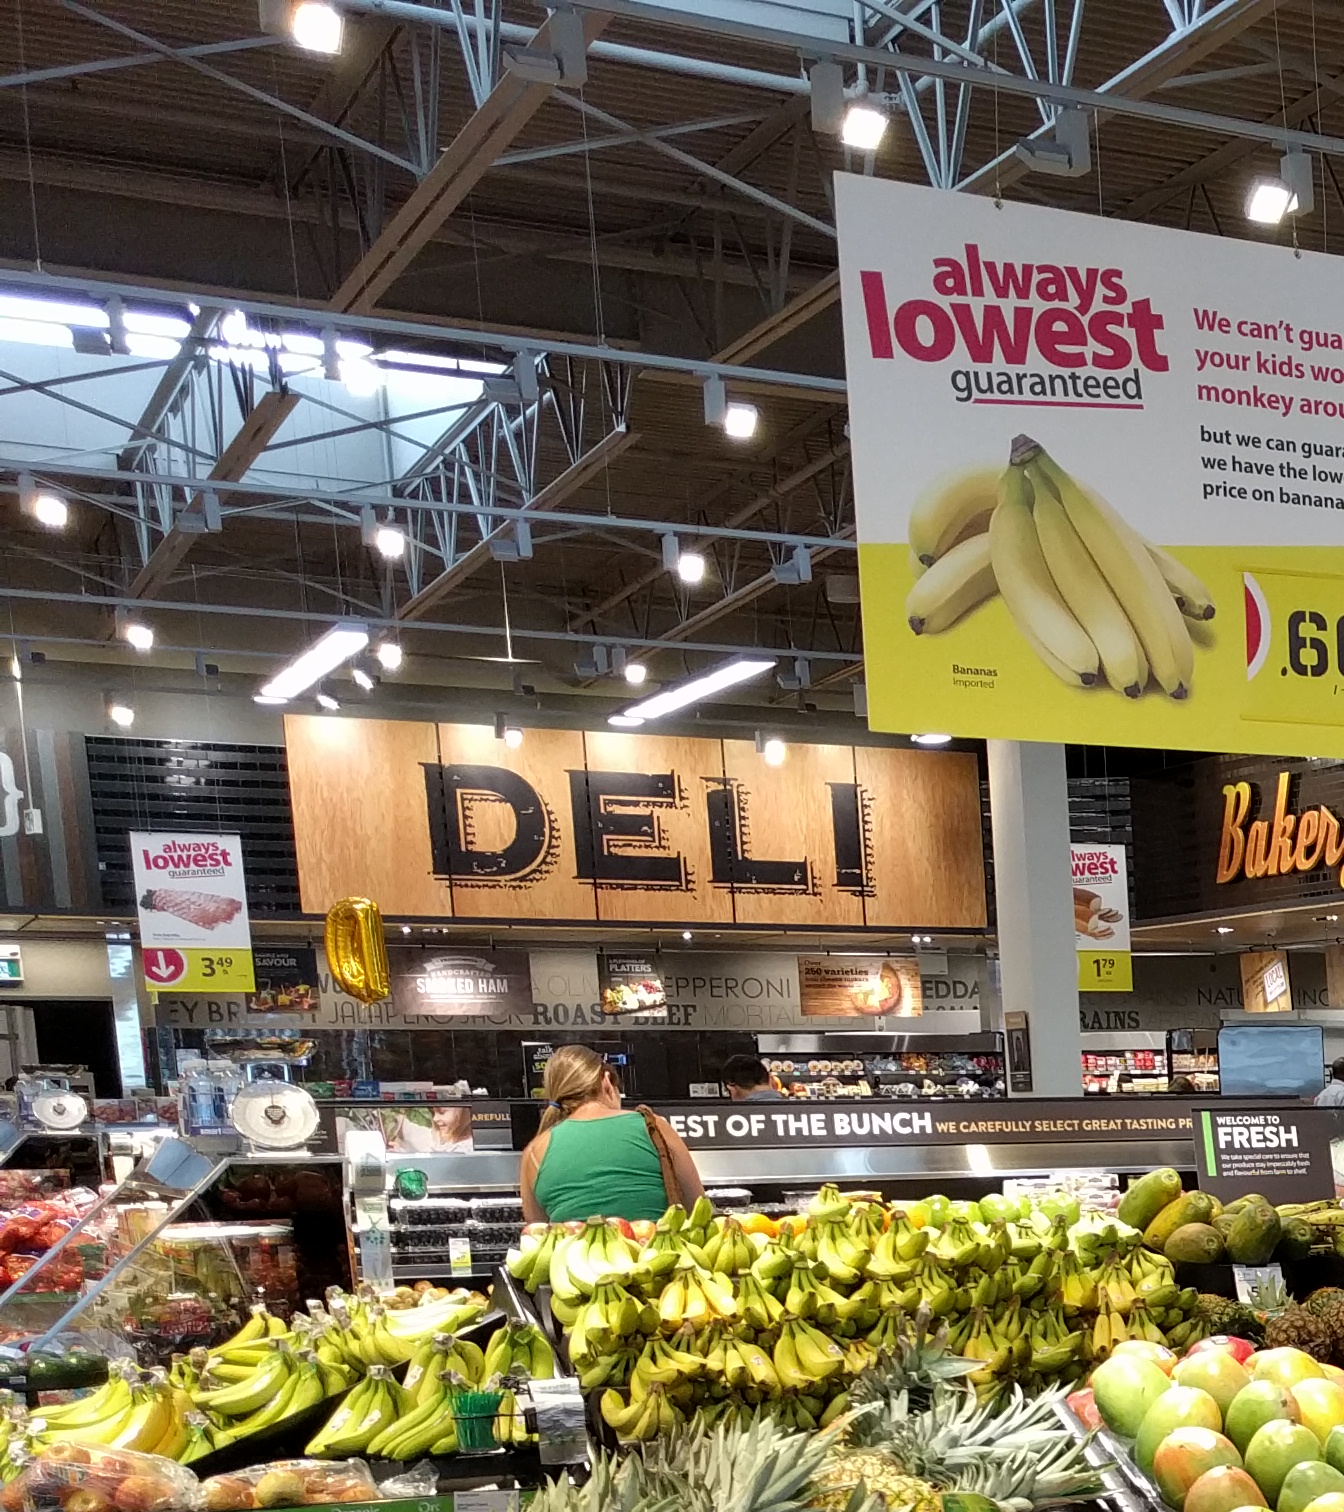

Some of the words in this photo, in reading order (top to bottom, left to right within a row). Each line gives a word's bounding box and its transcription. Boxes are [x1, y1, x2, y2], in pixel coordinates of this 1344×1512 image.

[933, 243, 1128, 316] always
[860, 270, 1169, 372] lowest
[1193, 308, 1231, 334] We
[1195, 349, 1251, 371] your
[1257, 351, 1305, 379] kids
[950, 367, 1143, 402] guaranteed
[1197, 384, 1294, 417] monkey
[1200, 425, 1232, 446] but
[1236, 433, 1261, 449] we
[1266, 437, 1297, 453] can
[1201, 455, 1227, 471] we
[1231, 456, 1275, 476] have
[1279, 462, 1308, 480] the
[1203, 482, 1247, 499] price
[1252, 488, 1275, 503] on
[952, 664, 998, 677] Bananas
[418, 762, 873, 897] DELI
[143, 848, 232, 870] lowest
[162, 840, 219, 854] always
[168, 867, 225, 878] guaranteed
[478, 979, 508, 993] HAM
[726, 1114, 765, 1137] OF
[771, 1113, 827, 1137] THE
[834, 1112, 933, 1135] BUNCH
[936, 1121, 957, 1133] WE
[959, 1120, 1032, 1133] CAREFULLY
[1035, 1119, 1080, 1132] SELECT
[1083, 1118, 1123, 1132] GREAT
[1125, 1118, 1172, 1131] TASTING
[1216, 1116, 1265, 1125] WELCOME
[1266, 1115, 1280, 1124] TO
[1217, 1125, 1298, 1149] FRESH
